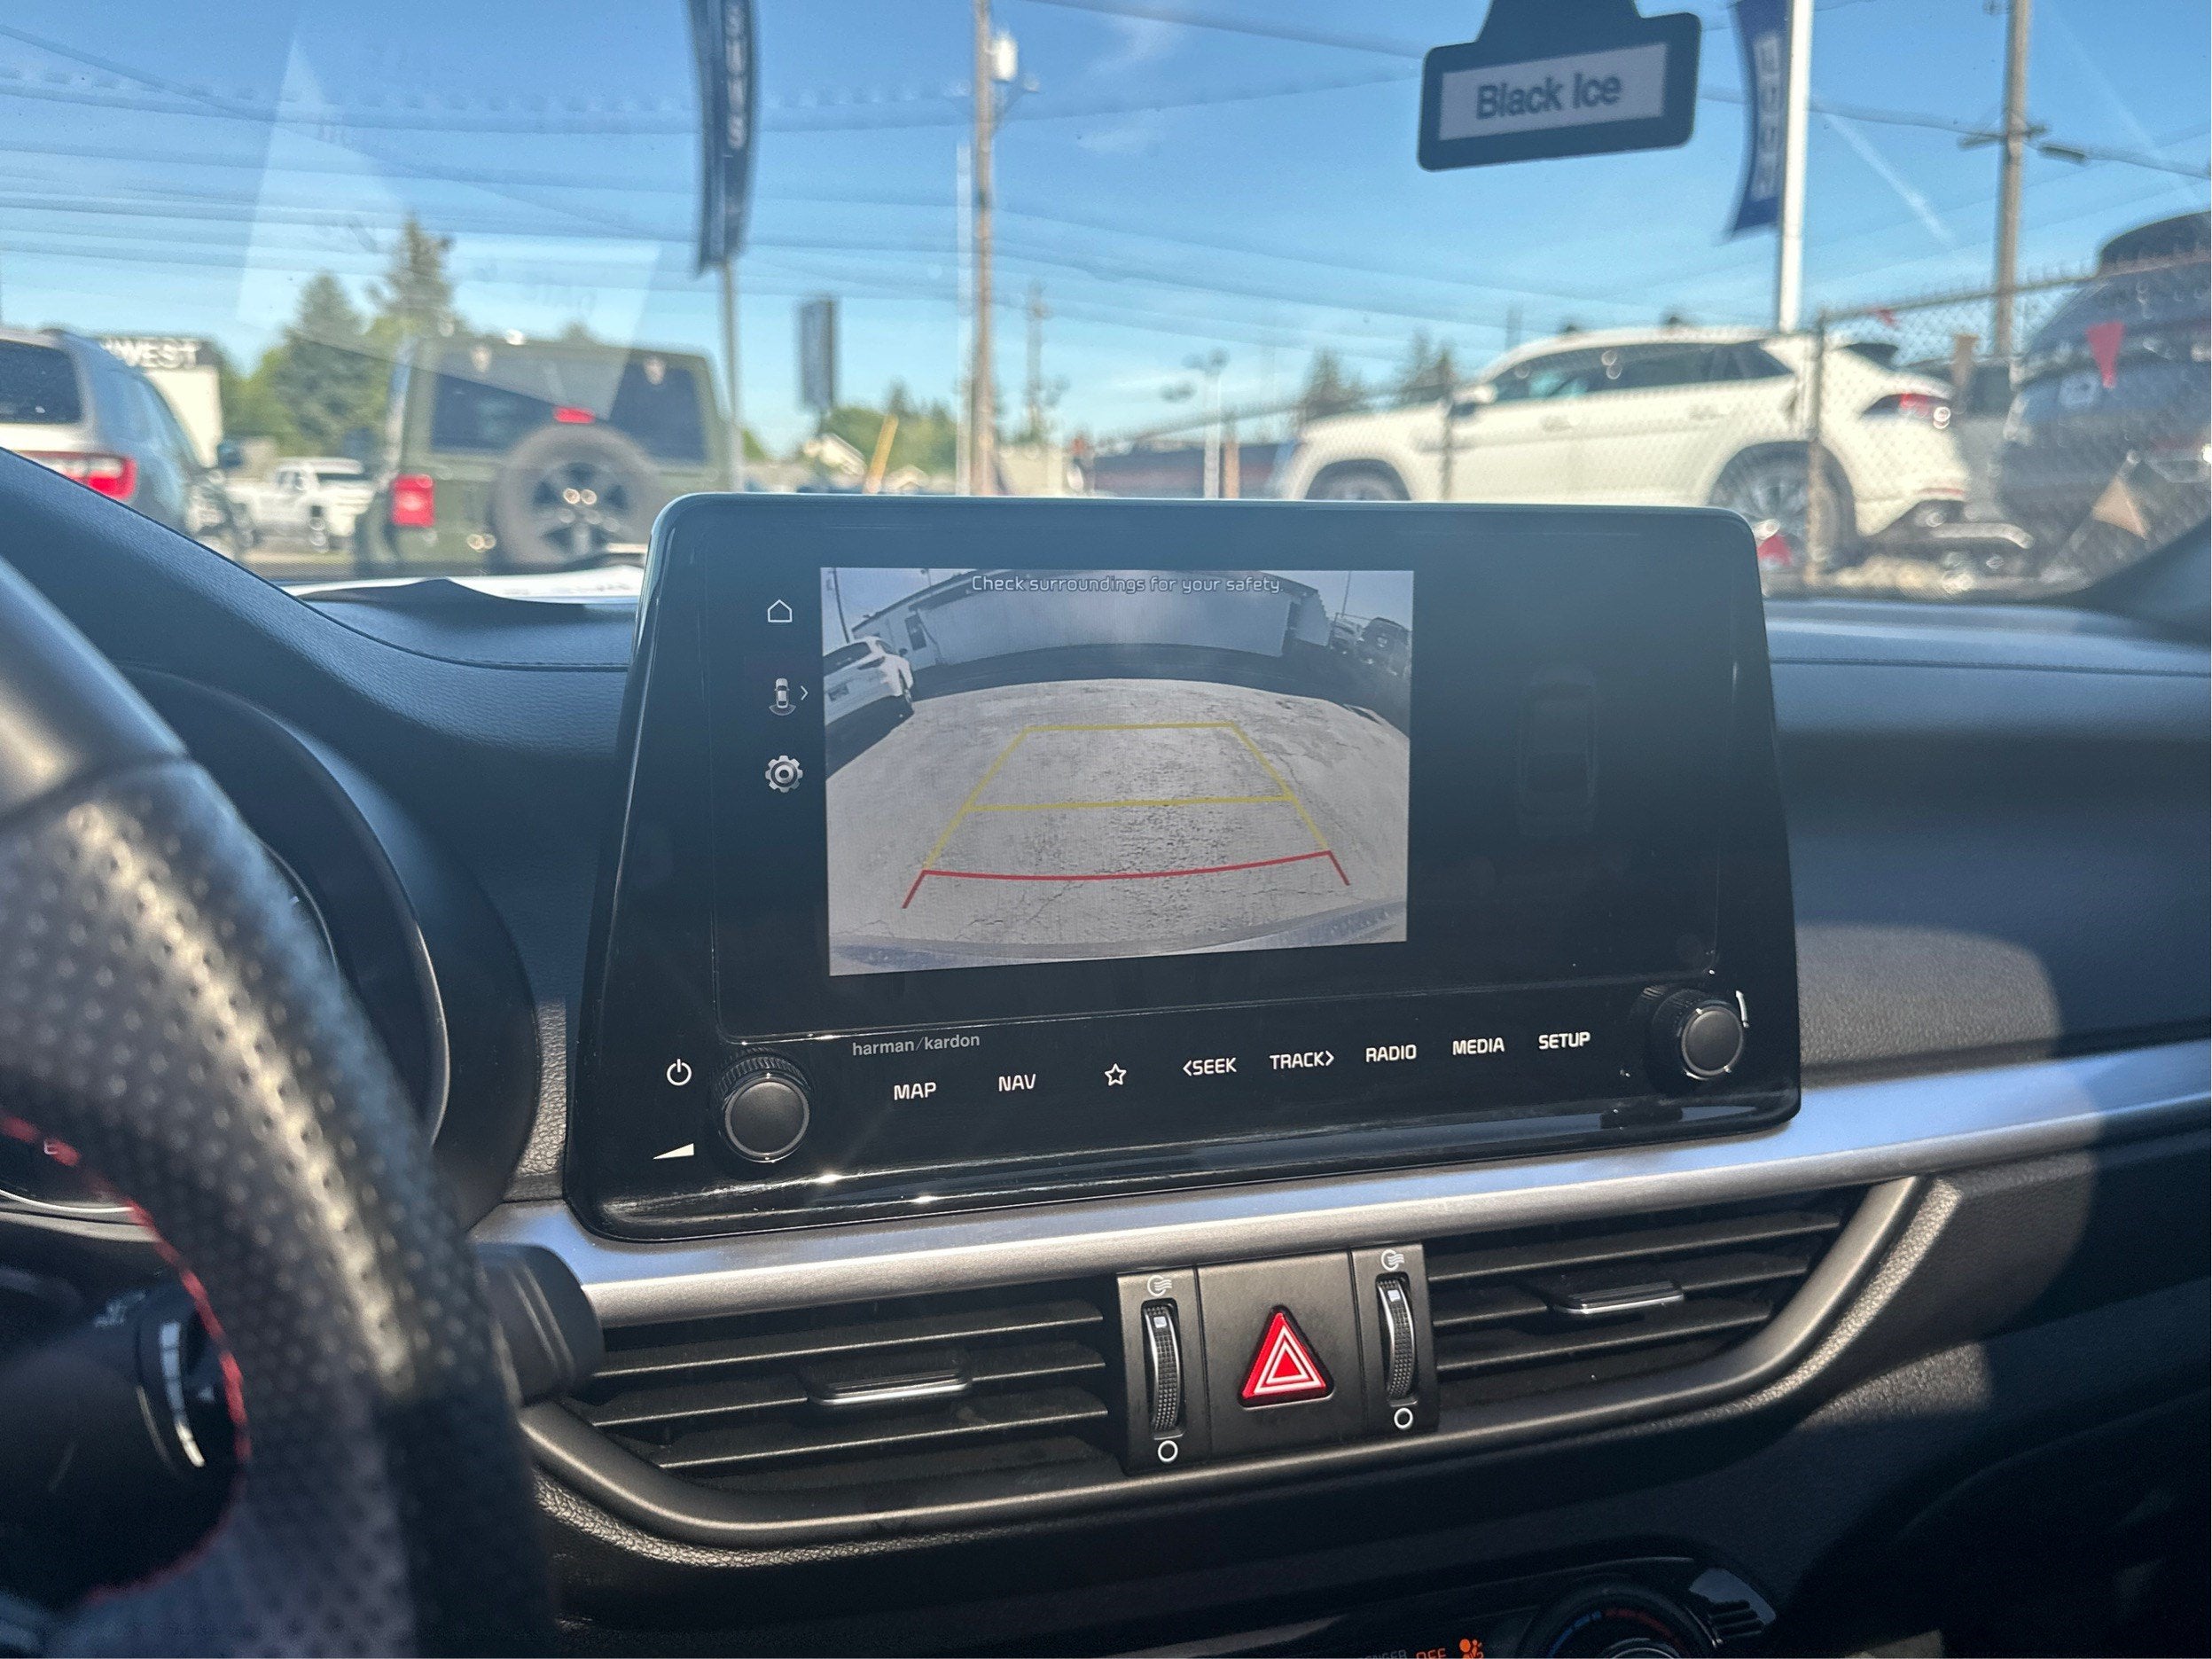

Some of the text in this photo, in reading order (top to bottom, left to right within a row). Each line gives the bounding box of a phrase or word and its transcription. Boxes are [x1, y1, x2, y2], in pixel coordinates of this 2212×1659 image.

[1476, 72, 1621, 120] Black Ice
[99, 340, 197, 367] WEST
[973, 576, 1284, 593] Check surroundings for your safety.
[1452, 1037, 1505, 1055] MEDIA
[1538, 1031, 1591, 1050] SETUP
[1366, 1045, 1417, 1062] RADIO
[894, 1082, 937, 1100] MAP
[998, 1073, 1036, 1092] NAV
